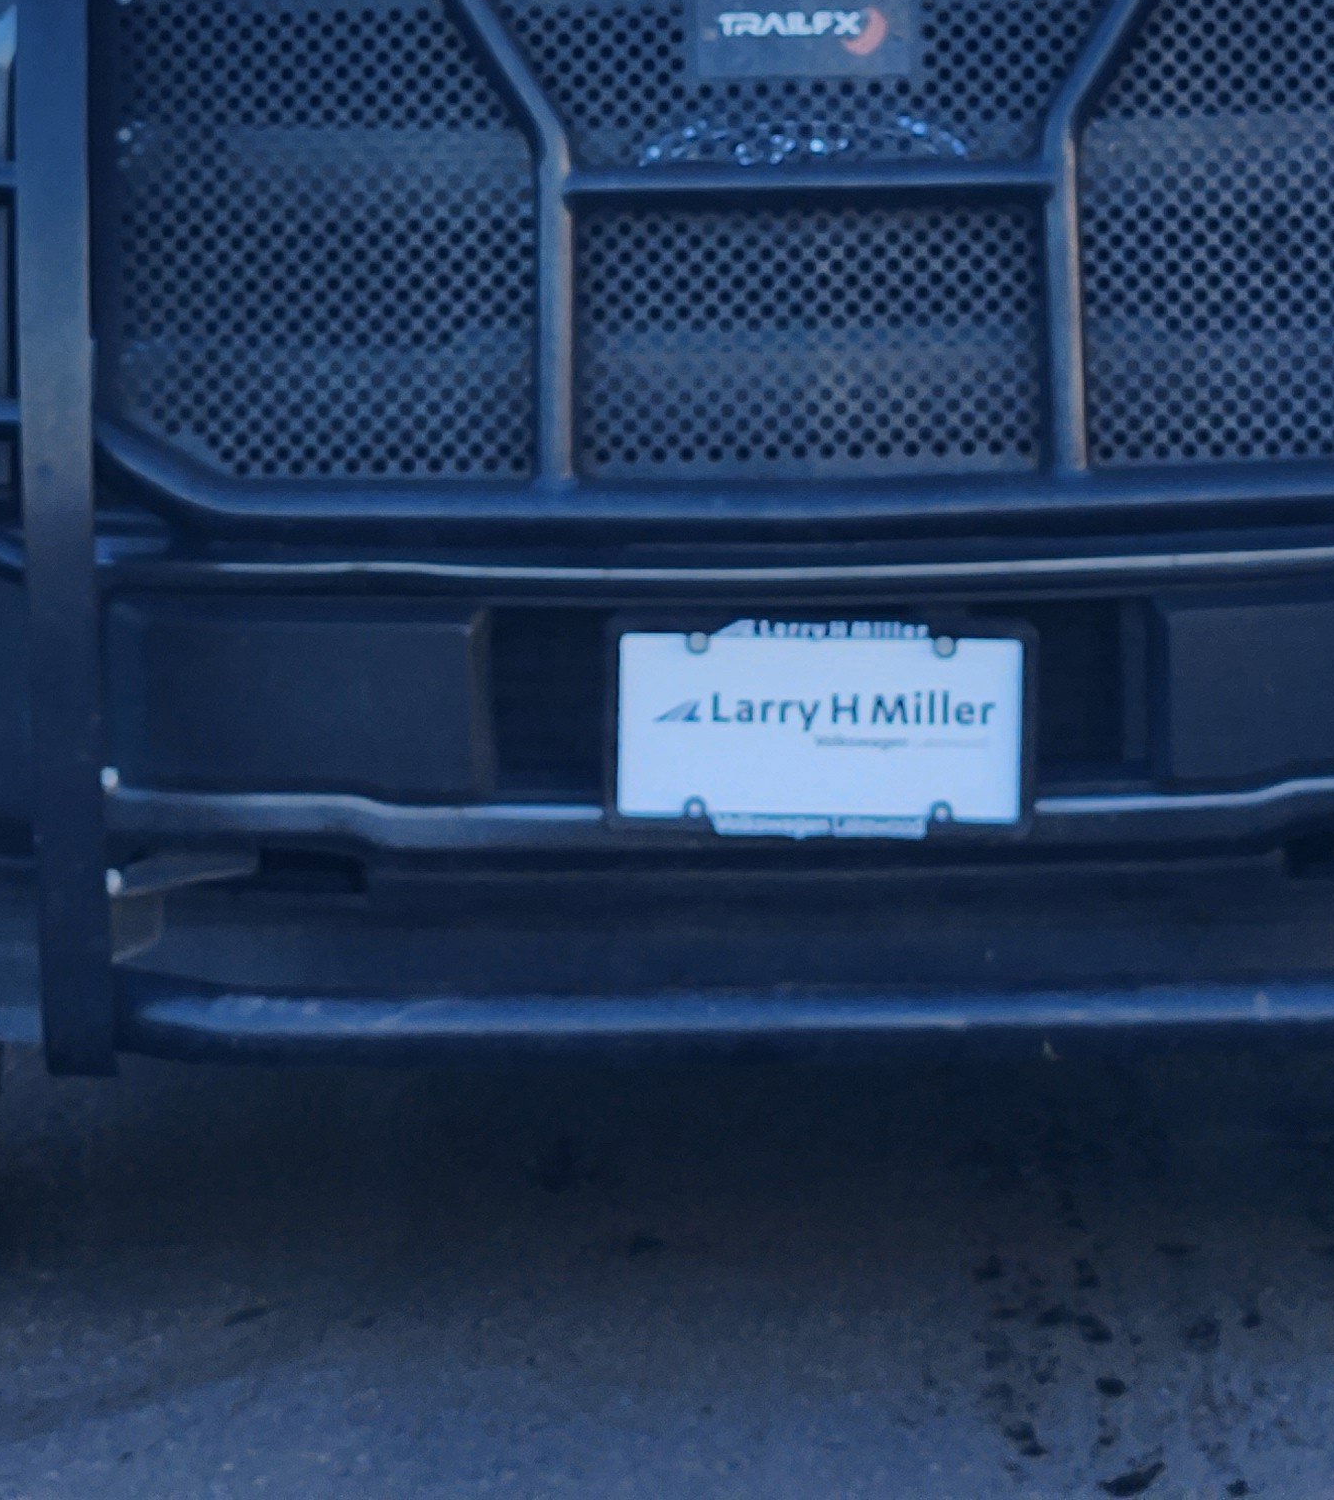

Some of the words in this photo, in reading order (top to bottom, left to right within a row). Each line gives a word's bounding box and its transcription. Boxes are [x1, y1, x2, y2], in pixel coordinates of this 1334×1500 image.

[718, 11, 862, 36] TRAILFX
[711, 692, 819, 732] Larry
[832, 693, 859, 724] H
[870, 690, 996, 726] Miller
